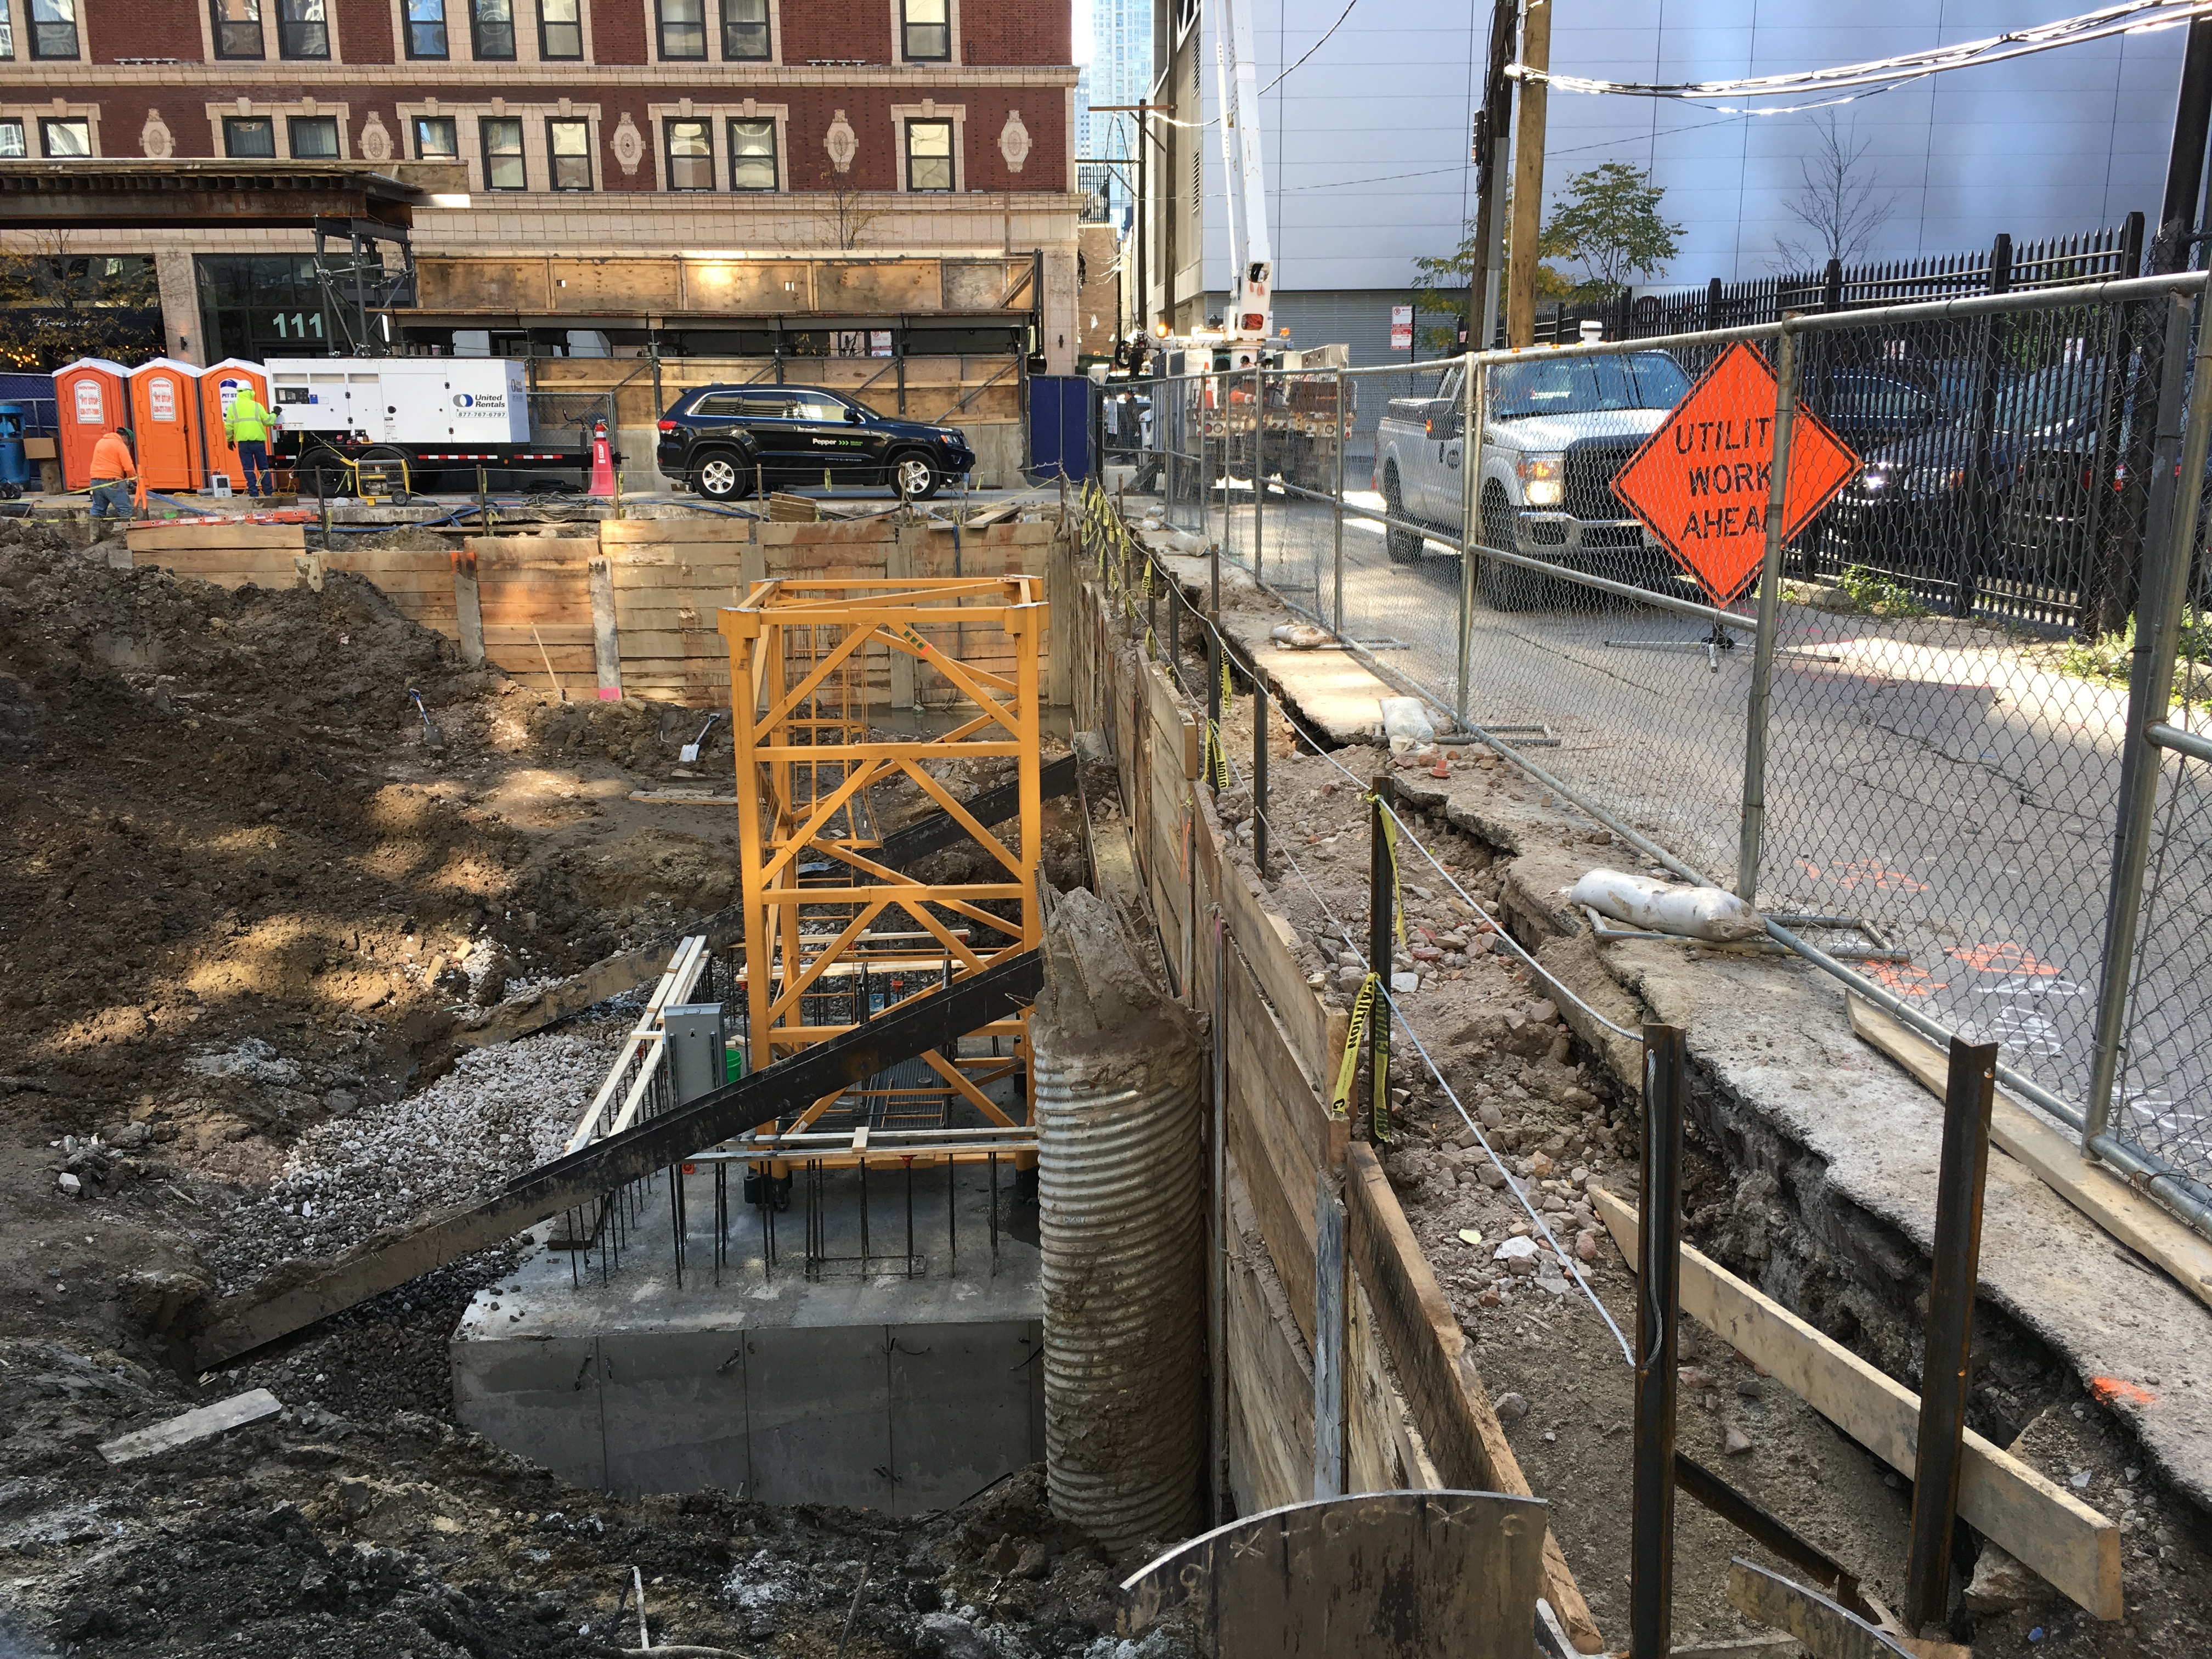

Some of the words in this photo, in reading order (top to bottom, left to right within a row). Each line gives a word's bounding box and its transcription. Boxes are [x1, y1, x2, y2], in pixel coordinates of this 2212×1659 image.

[273, 313, 323, 337] 111
[812, 438, 837, 446] Pepper
[1676, 417, 1772, 454] UTILIT
[1689, 461, 1773, 497] WORK
[1680, 504, 1768, 541] AHEA
[1347, 981, 1373, 1049] CAUTION
